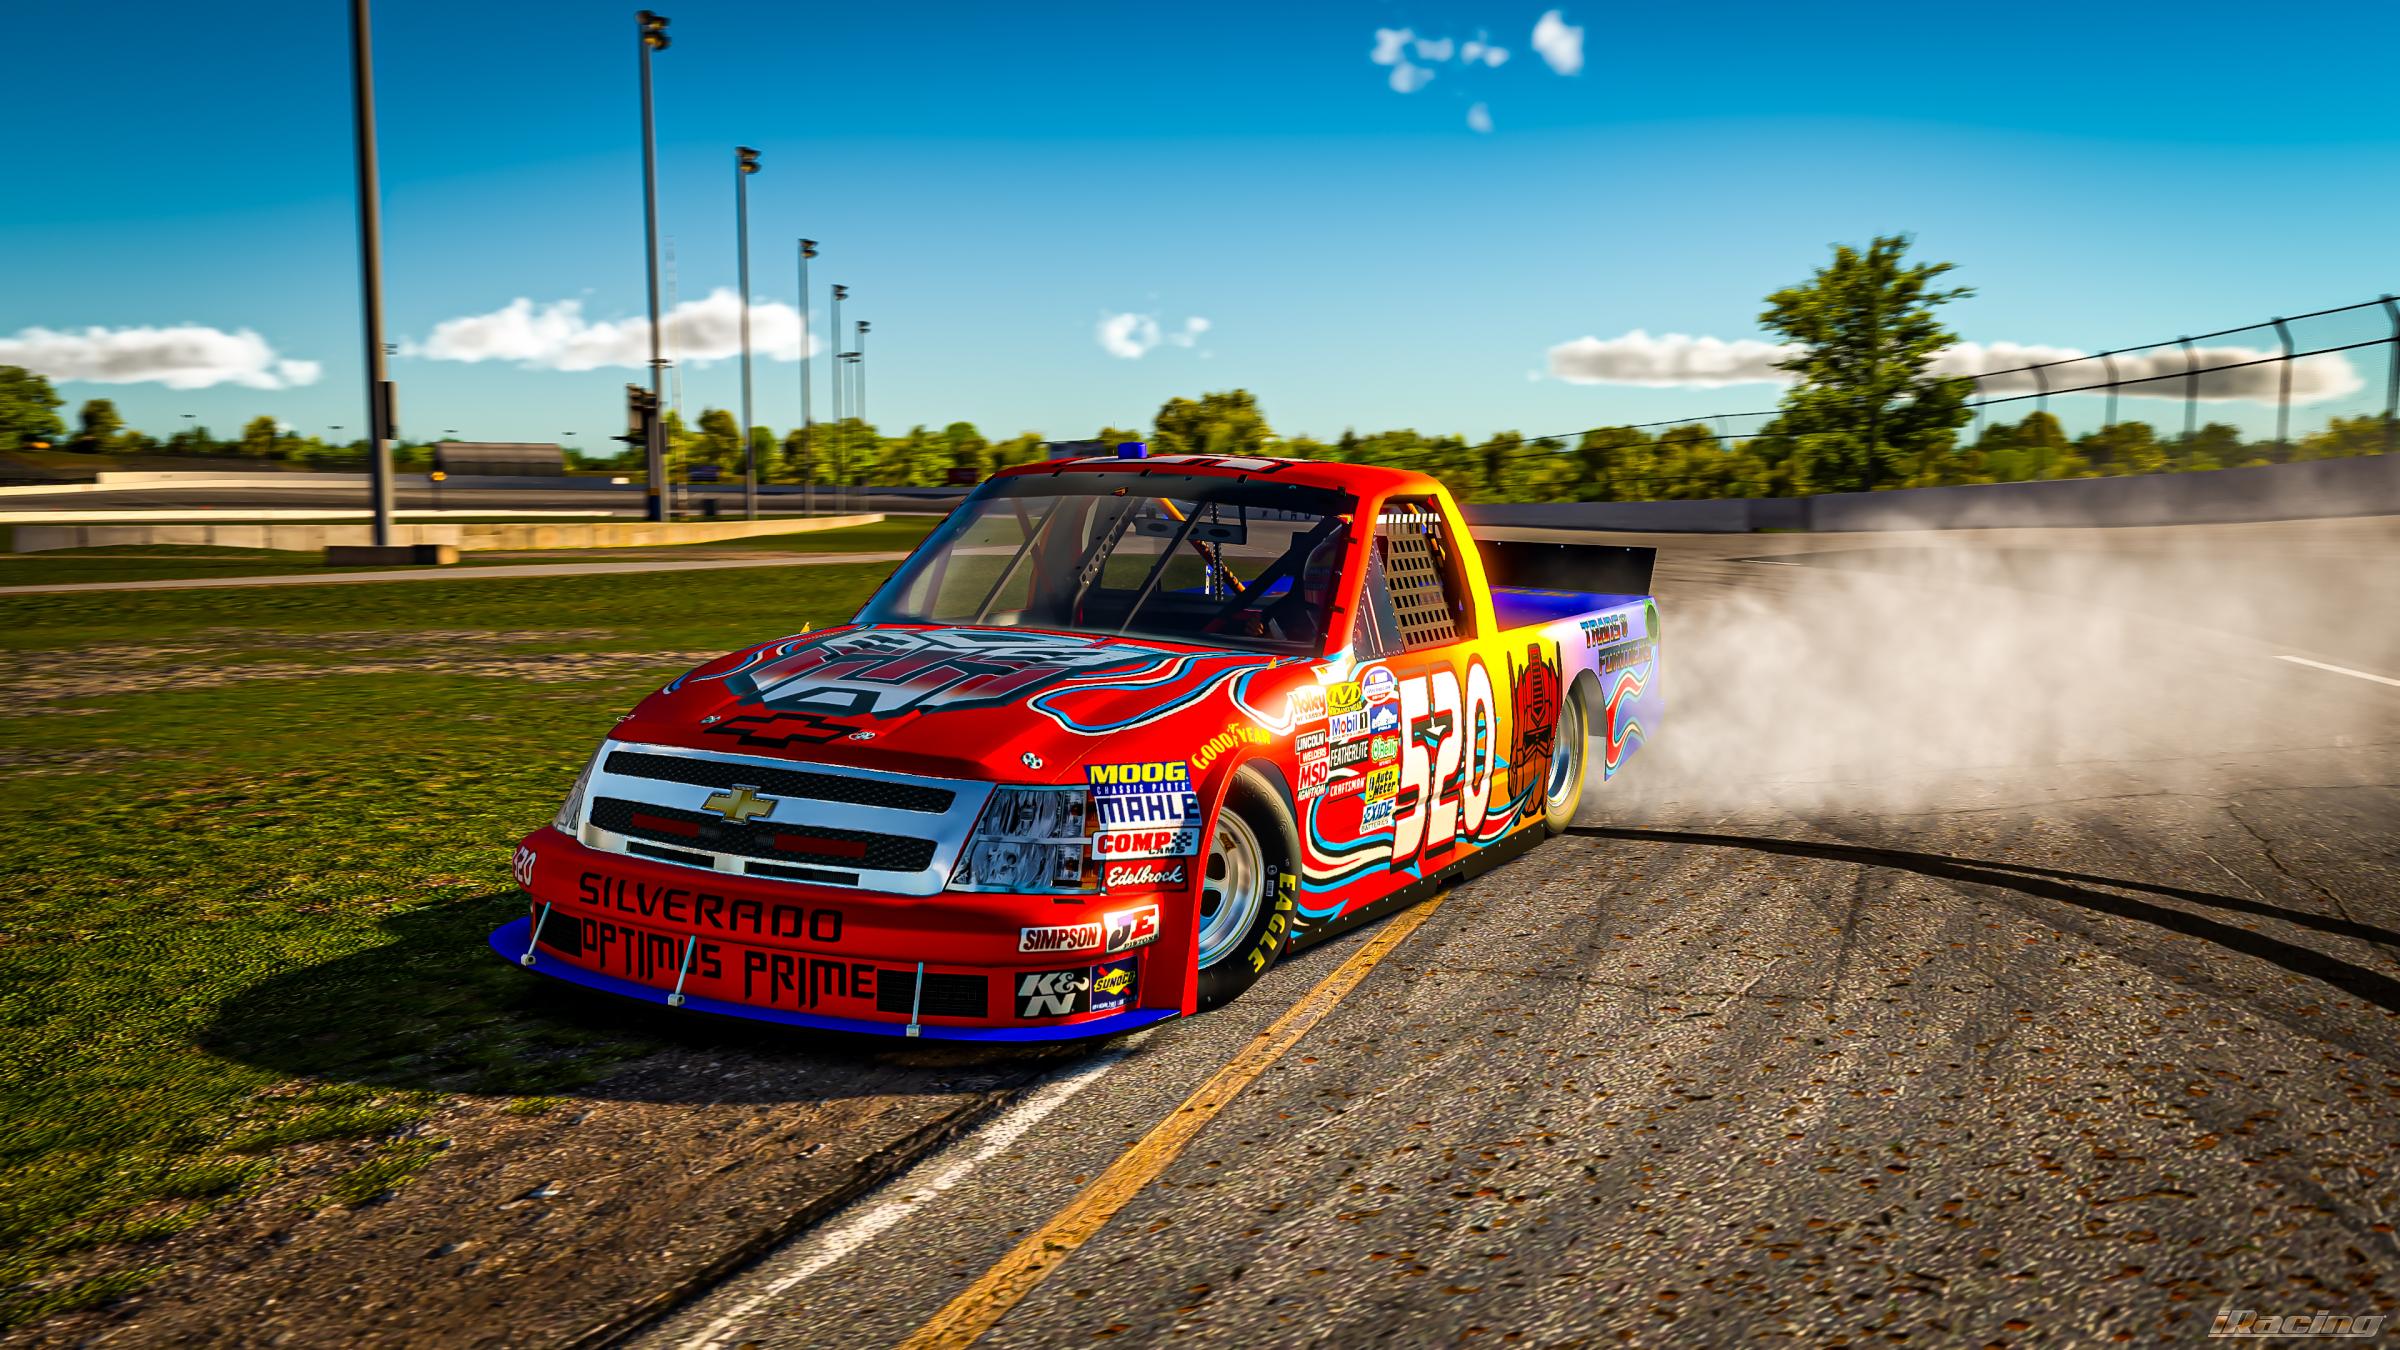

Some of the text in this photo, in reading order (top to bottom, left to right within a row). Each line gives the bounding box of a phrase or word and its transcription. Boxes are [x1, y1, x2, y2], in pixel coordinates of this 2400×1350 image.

[1332, 713, 1358, 736] Mobil
[1191, 724, 1271, 770] GOODYEAR
[1297, 732, 1325, 751] LINCOLN
[1302, 748, 1327, 762] WELDERS
[1330, 740, 1368, 767] FEATHERLITE
[1391, 662, 1496, 868] 520
[1090, 761, 1187, 784] MOOG
[1299, 761, 1328, 789] MSD
[1376, 770, 1393, 784] Auto
[1096, 782, 1186, 795] CHASSIS PARTS
[1330, 777, 1365, 797] CRAFTSMAN
[1374, 780, 1396, 796] Meter
[1096, 793, 1201, 824] MAHLE
[1363, 800, 1394, 824] EXIDE
[1361, 819, 1389, 833] BATTERIES
[1097, 832, 1171, 854] COMP
[1148, 846, 1186, 855] CAMS
[513, 846, 537, 886] 20
[1107, 865, 1184, 888] Edelbrock
[579, 872, 844, 943] SILVERADO
[1108, 908, 1157, 950] JE
[1248, 872, 1297, 974] EAGLE
[1023, 926, 1098, 951] SIMPSON
[1123, 934, 1159, 949] PISTONS
[582, 917, 876, 1009] OPTIMUS PRIME
[1095, 972, 1135, 991] SUNOCO
[1018, 971, 1090, 1017] K&N
